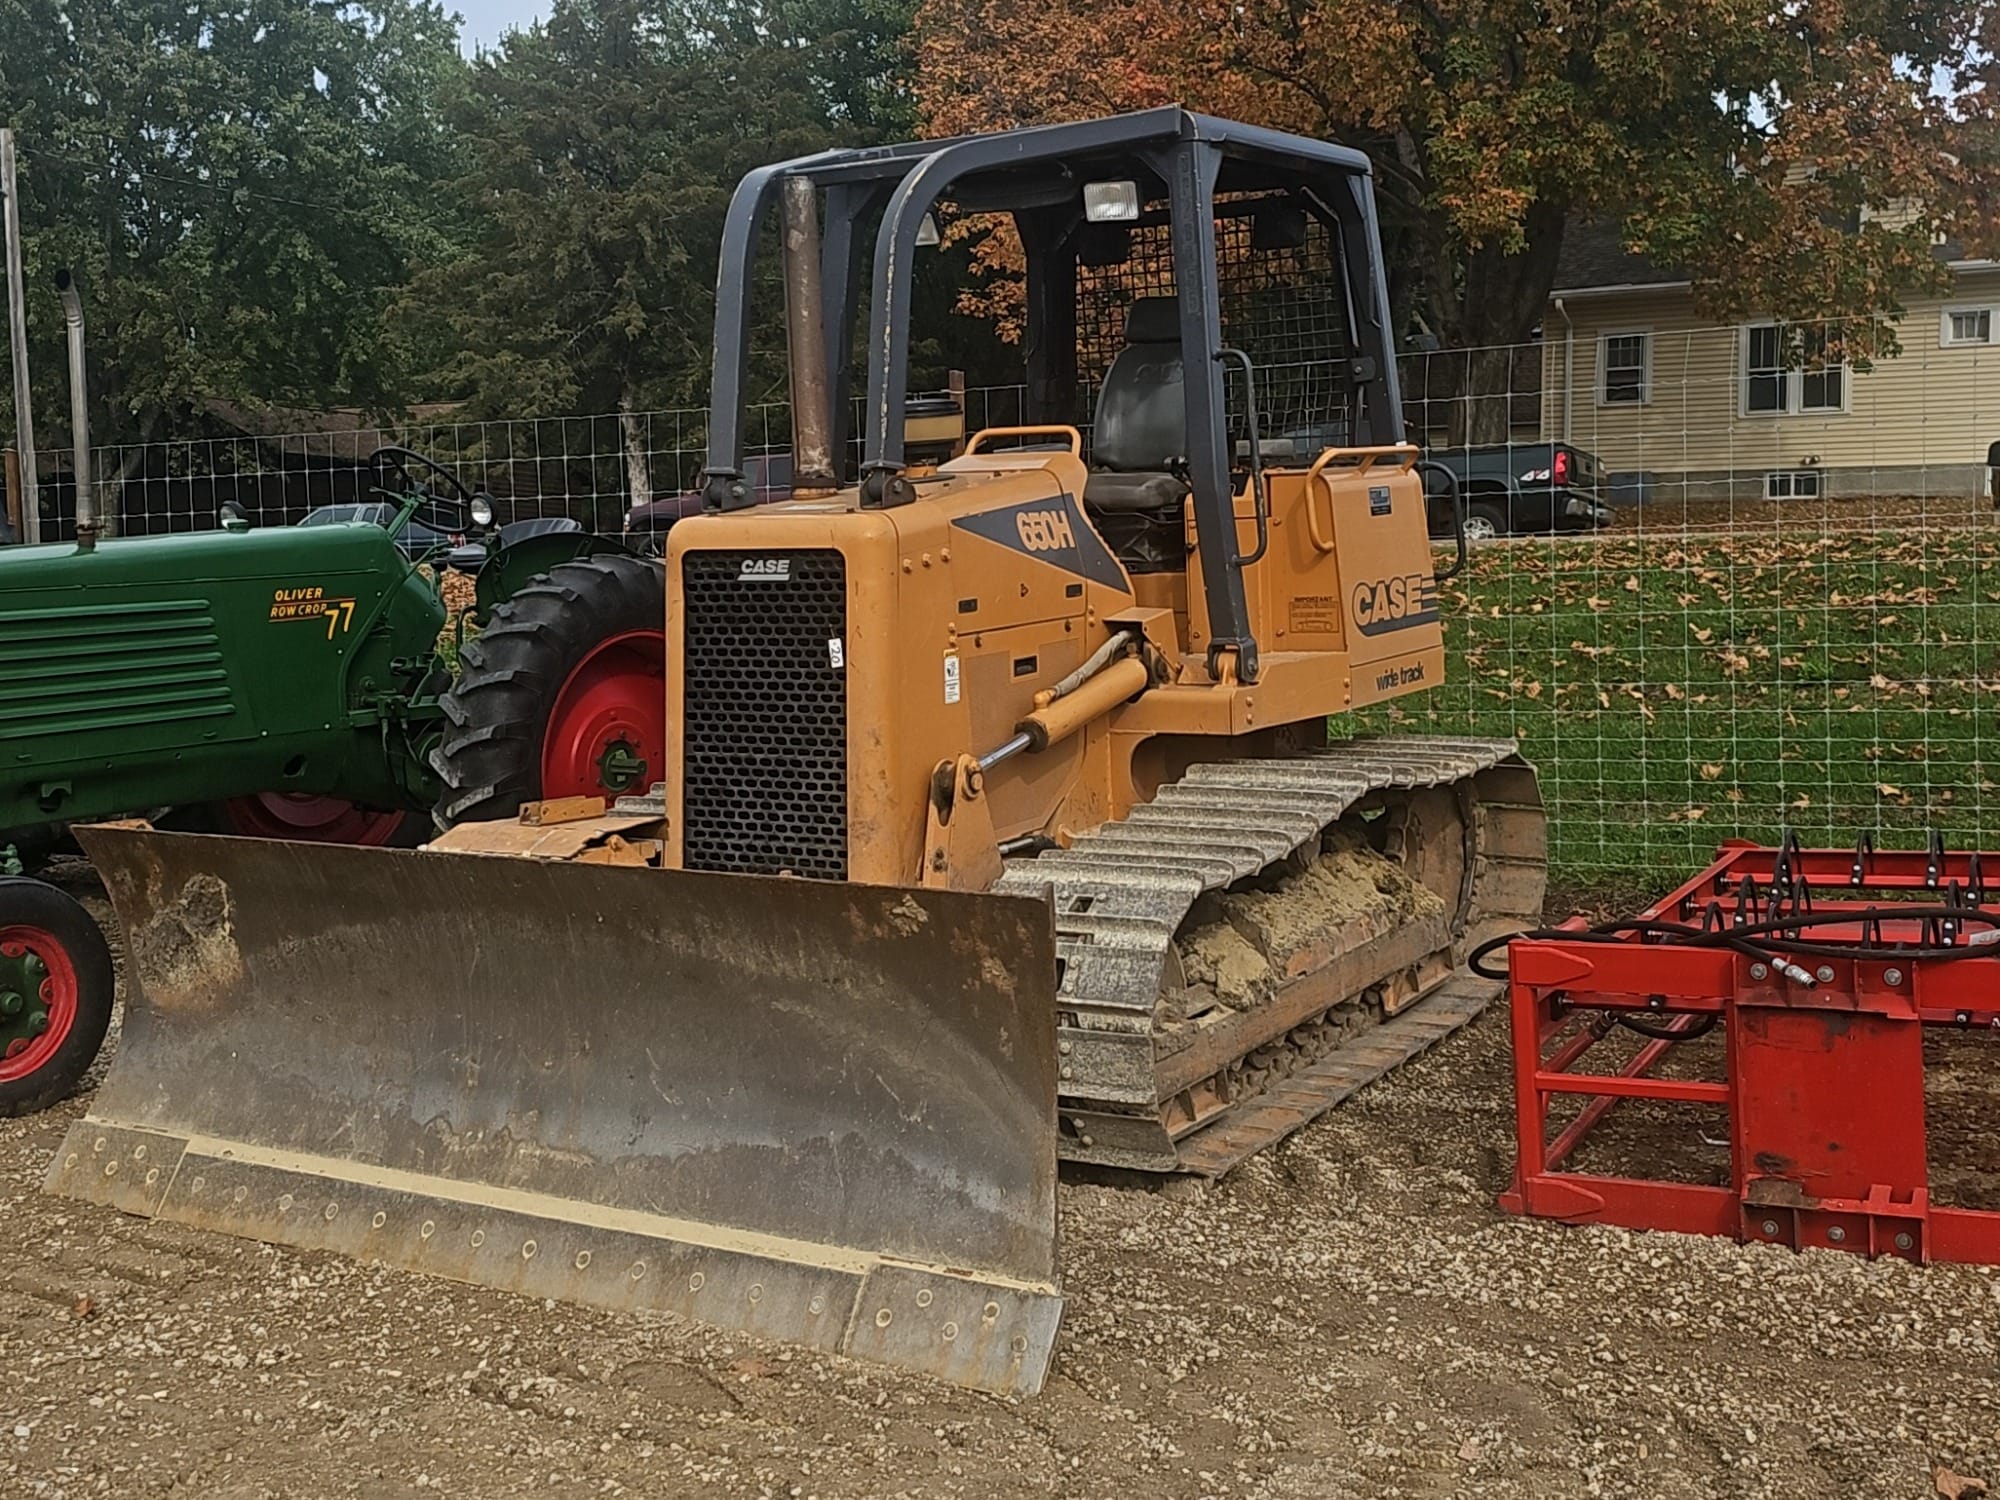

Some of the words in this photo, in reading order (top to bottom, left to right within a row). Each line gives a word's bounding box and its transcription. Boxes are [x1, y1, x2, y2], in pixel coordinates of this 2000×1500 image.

[1015, 510, 1077, 551] 650H
[740, 559, 790, 574] CASE
[270, 606, 297, 618] ROW
[297, 603, 328, 616] CROP
[274, 587, 323, 602] OLIVER
[1352, 574, 1422, 627] CASE
[324, 601, 356, 641] 77
[1375, 667, 1400, 692] wide
[1400, 660, 1425, 685] track
